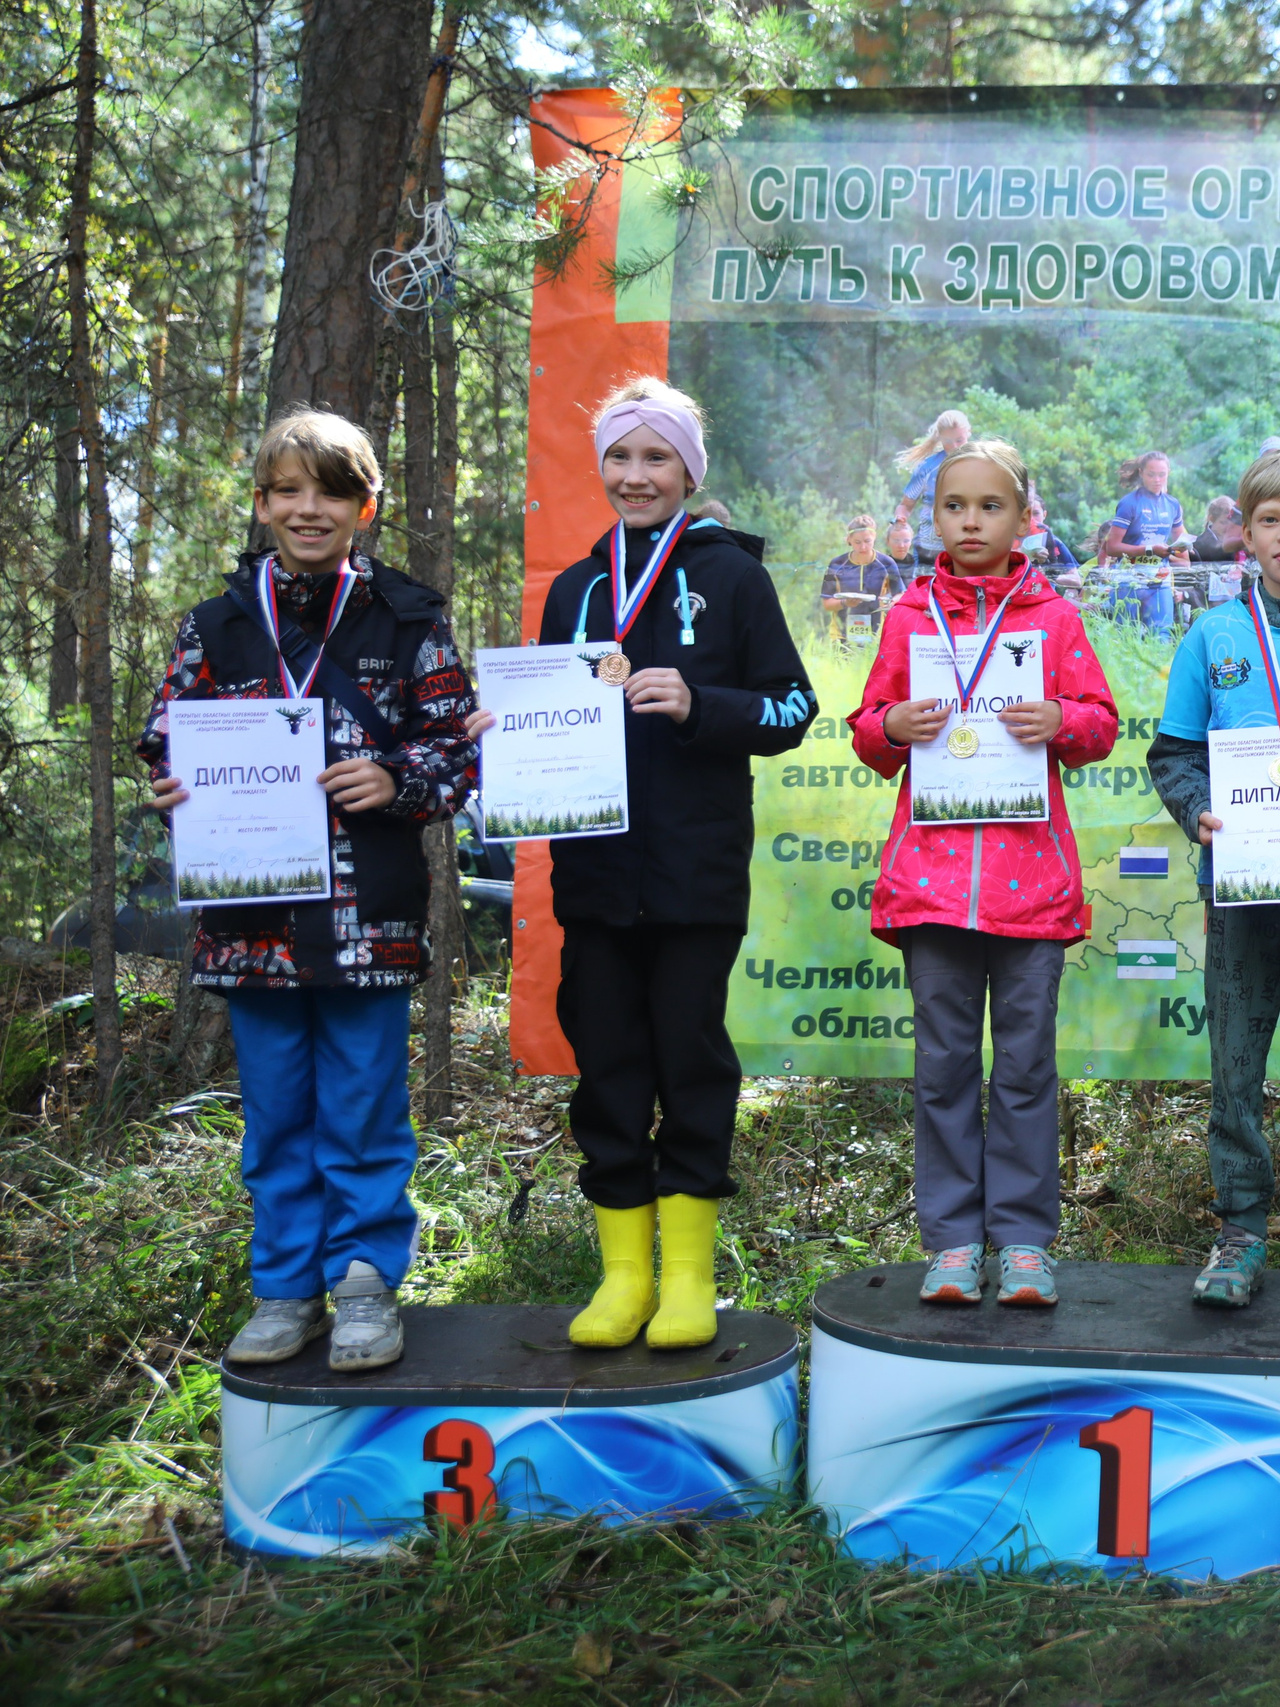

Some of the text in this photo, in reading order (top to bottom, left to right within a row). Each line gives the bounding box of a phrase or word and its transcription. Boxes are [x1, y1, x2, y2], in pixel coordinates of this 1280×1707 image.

[748, 164, 1168, 222] СПОРТИВНОЕ
[711, 245, 867, 302] ПУТЬ
[889, 245, 925, 302] К
[502, 706, 602, 732] ДИПЛОМ
[194, 765, 300, 787] ДИПЛОМ
[1062, 765, 1154, 796] окру
[423, 1418, 498, 1537] 3
[1079, 1405, 1154, 1557] 1
